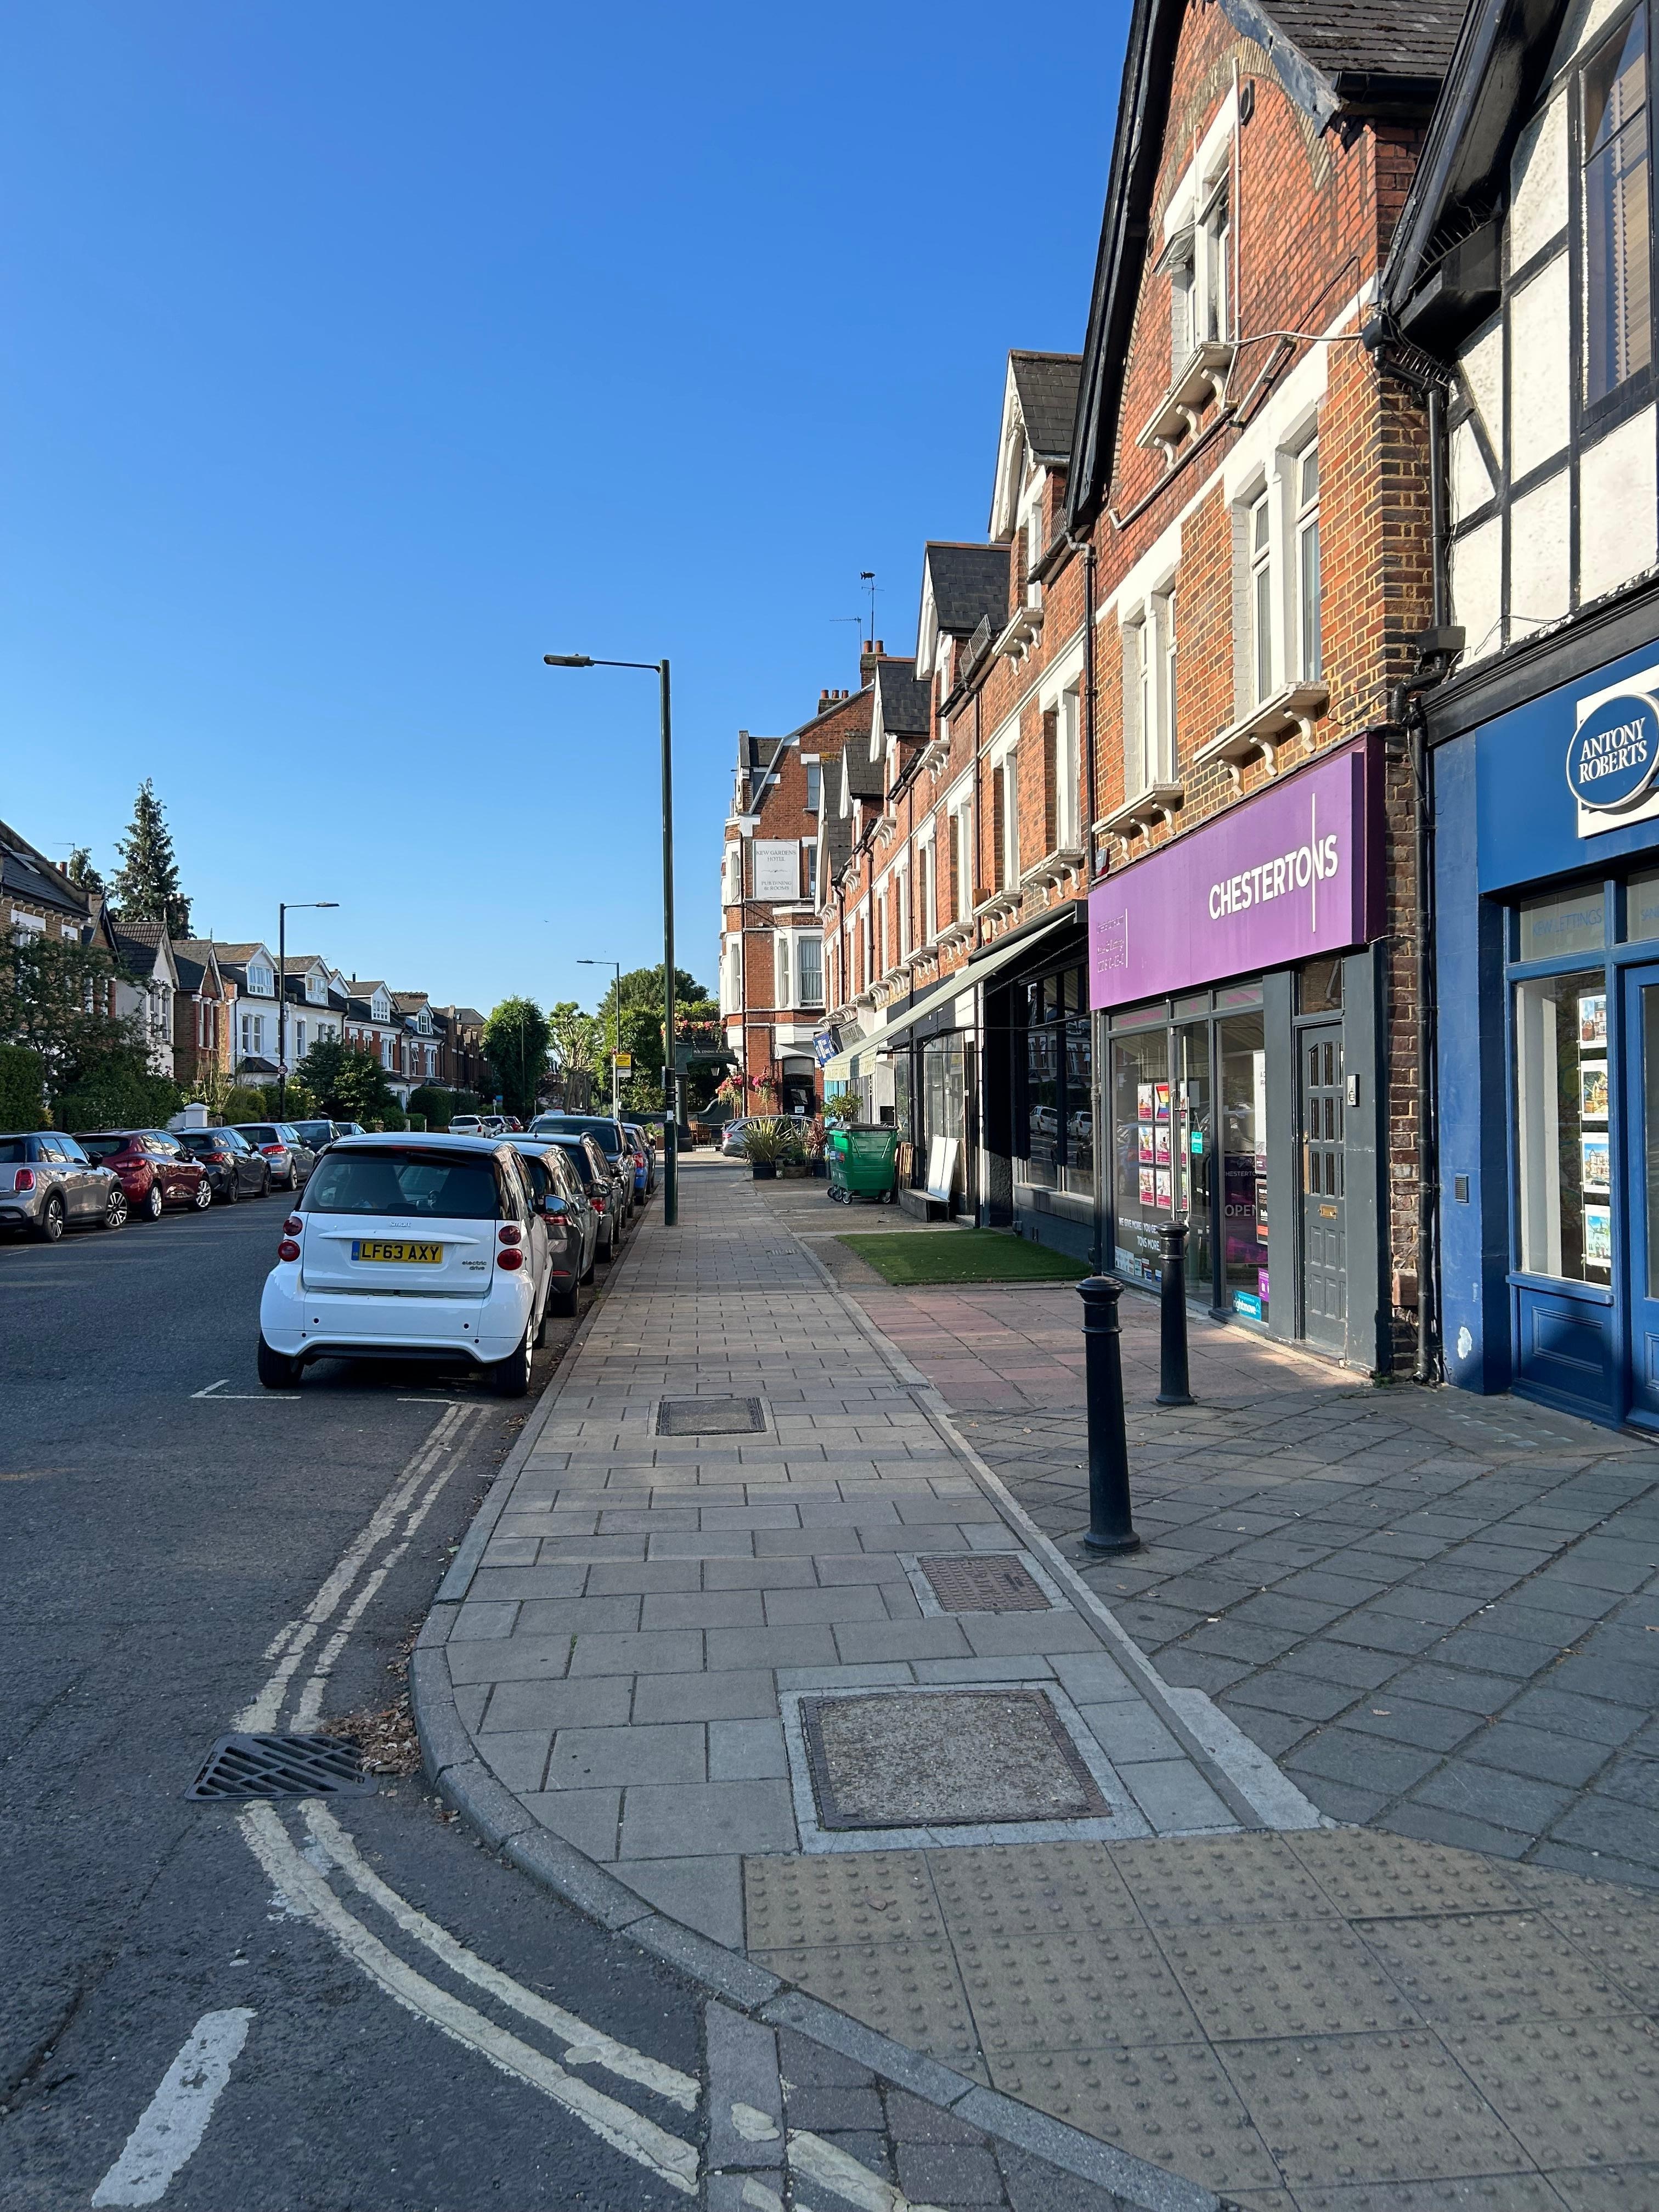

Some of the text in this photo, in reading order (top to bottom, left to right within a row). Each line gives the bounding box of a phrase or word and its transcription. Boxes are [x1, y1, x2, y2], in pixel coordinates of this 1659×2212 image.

[1580, 716, 1646, 761] ANTONY
[1578, 740, 1647, 784] ROBERTS
[1209, 831, 1339, 921] CHESTERTONS
[1555, 908, 1602, 933] LETTINGS
[362, 1243, 439, 1261] LF63 AXY
